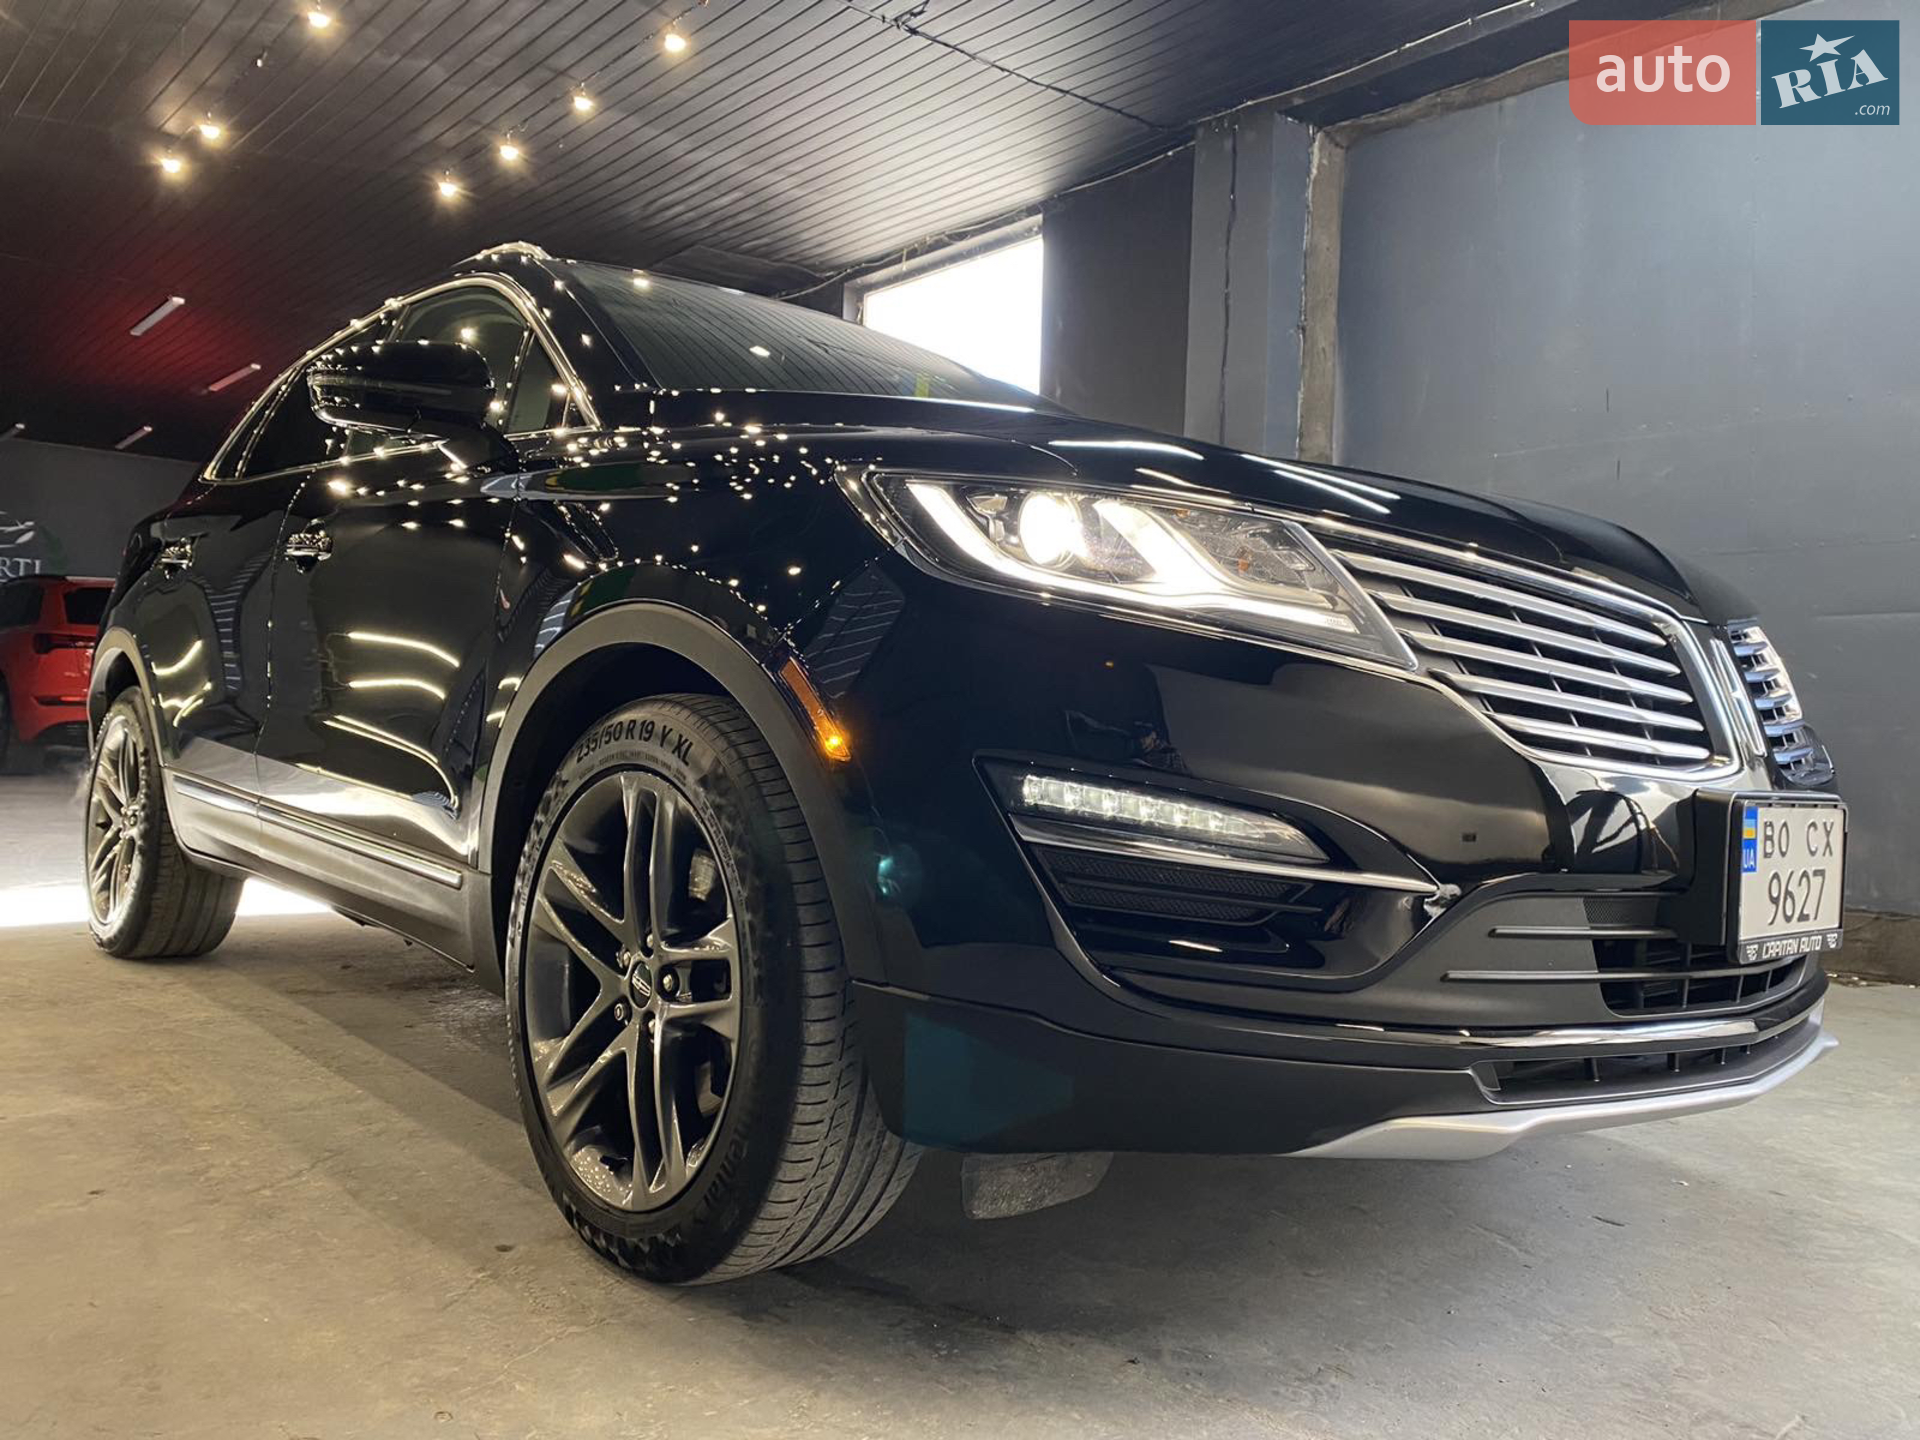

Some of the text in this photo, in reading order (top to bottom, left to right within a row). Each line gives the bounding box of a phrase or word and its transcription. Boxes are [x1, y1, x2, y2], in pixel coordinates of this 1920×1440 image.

[576, 720, 624, 764] 235/50
[671, 734, 693, 767] XL
[1743, 849, 1756, 869] UA
[1763, 820, 1834, 859] BO CX
[1767, 868, 1826, 926] 9627
[1761, 934, 1822, 959] CAPITAN AUTO
